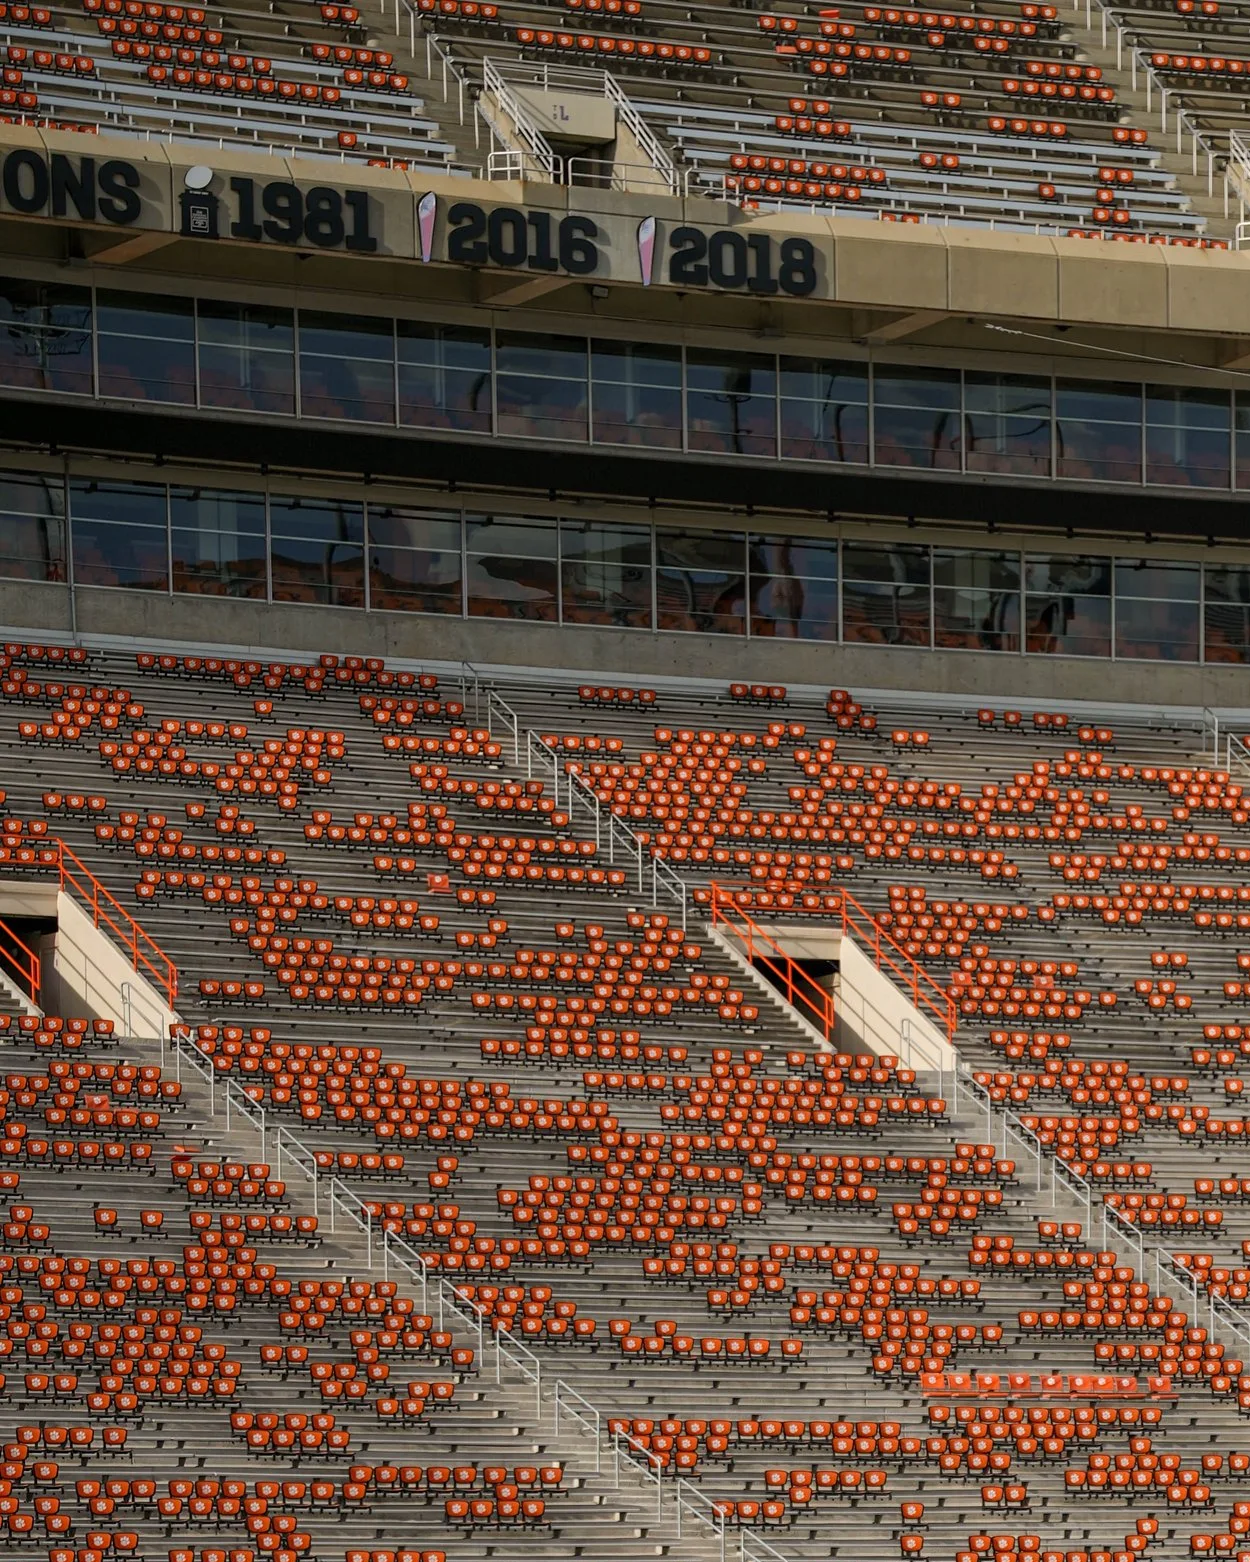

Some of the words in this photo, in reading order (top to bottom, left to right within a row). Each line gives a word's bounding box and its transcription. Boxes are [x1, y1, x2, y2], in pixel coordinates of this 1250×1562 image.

[229, 176, 377, 252] 1981
[447, 202, 598, 275] 2016
[669, 226, 817, 296] 2018
